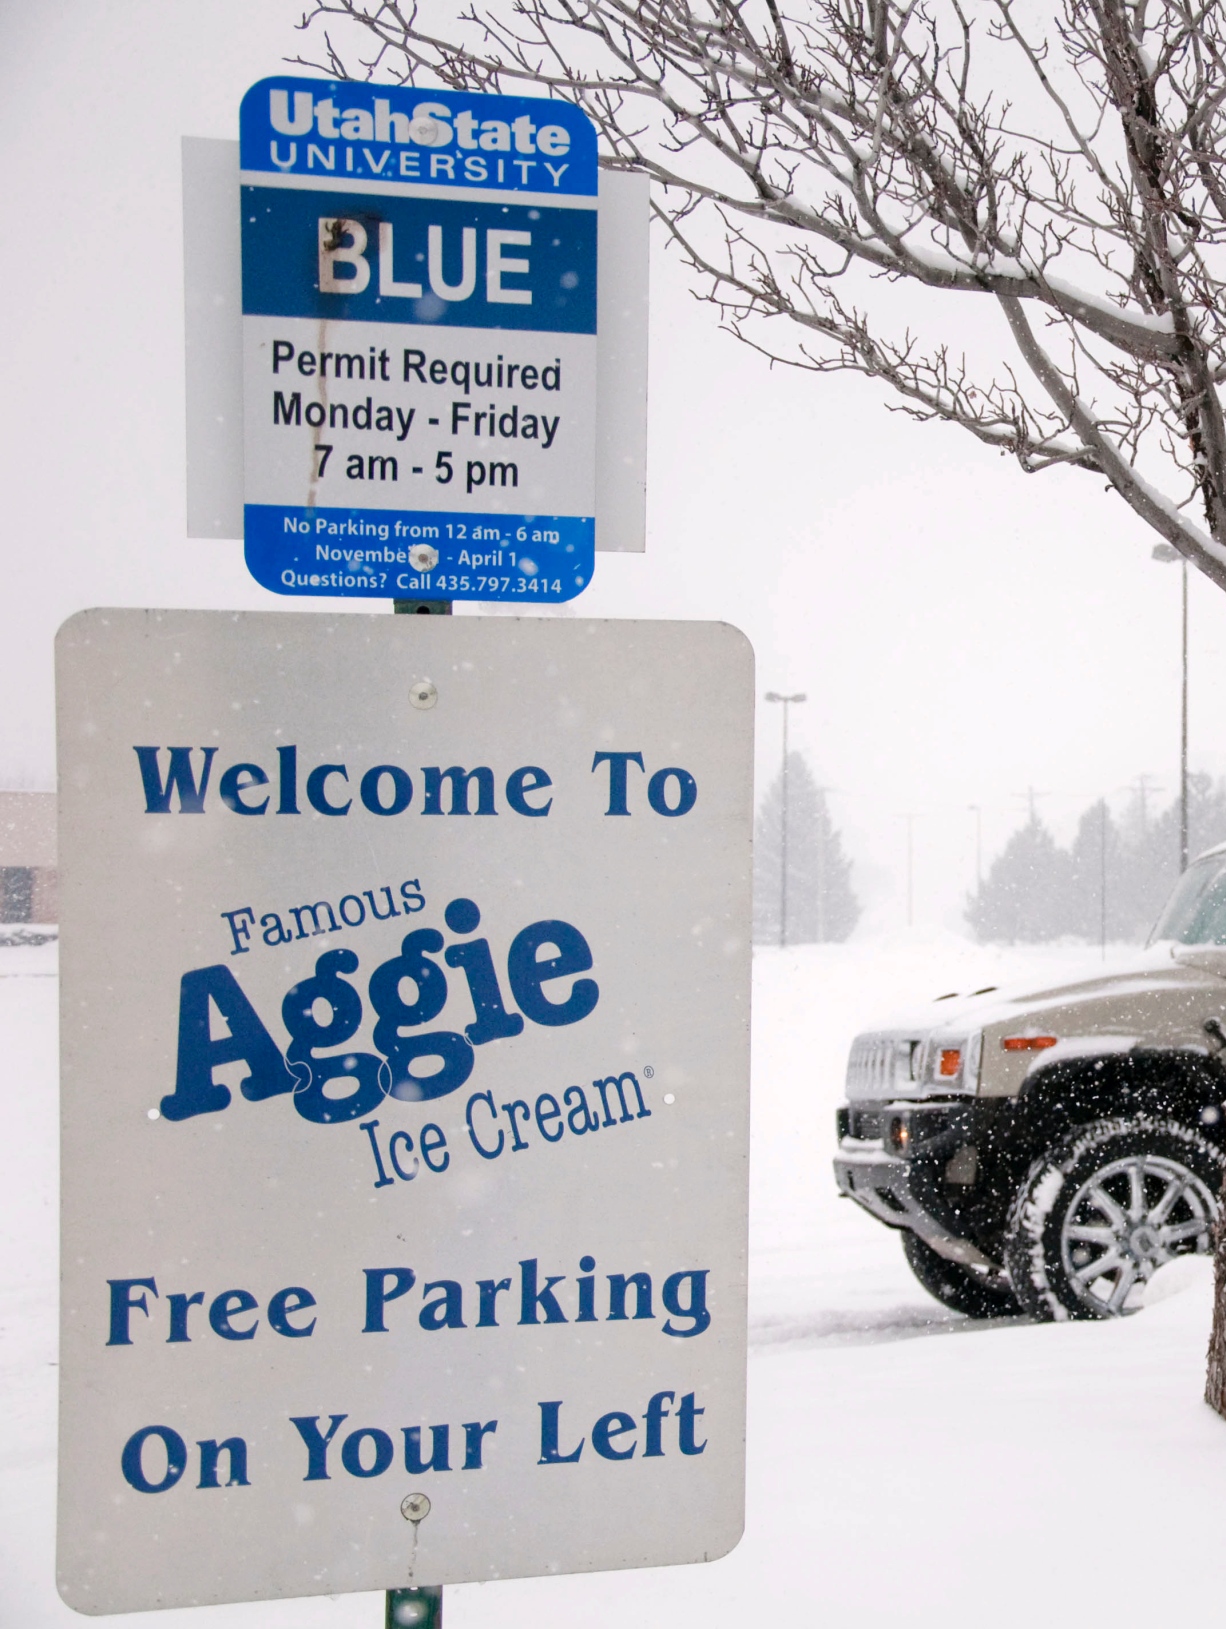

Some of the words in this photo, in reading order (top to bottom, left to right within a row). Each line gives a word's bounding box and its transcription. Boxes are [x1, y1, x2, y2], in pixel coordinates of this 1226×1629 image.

[269, 89, 571, 155] UtahState
[270, 140, 569, 187] UNIVERSITY
[318, 216, 533, 305] BLUE
[271, 340, 390, 382] Permit
[403, 348, 562, 394] Required
[272, 391, 415, 441] Monday
[451, 401, 561, 449] Friday
[314, 444, 333, 478] 7
[346, 454, 398, 481] am
[435, 451, 453, 484] 5
[467, 462, 519, 493] pm
[283, 516, 310, 534] No
[315, 518, 390, 541] Parking
[394, 521, 440, 539] from
[445, 524, 467, 540] 12
[472, 526, 500, 541] am
[516, 526, 528, 543] 6
[532, 528, 560, 544] am
[315, 544, 420, 564] Novembe
[458, 549, 503, 570] April
[508, 551, 517, 567] 1
[280, 569, 388, 590] Questions?
[396, 573, 431, 590] Call
[435, 576, 562, 594] 435.797.3414
[132, 744, 554, 818] Welcome
[591, 750, 698, 818] To
[220, 877, 427, 955] Famous
[159, 897, 601, 1125] Aggie
[359, 1118, 451, 1189] Ice
[104, 1275, 319, 1346] Free
[360, 1254, 712, 1338] Parking
[120, 1424, 253, 1494] On
[288, 1412, 500, 1482] Your
[536, 1390, 709, 1466] Left
